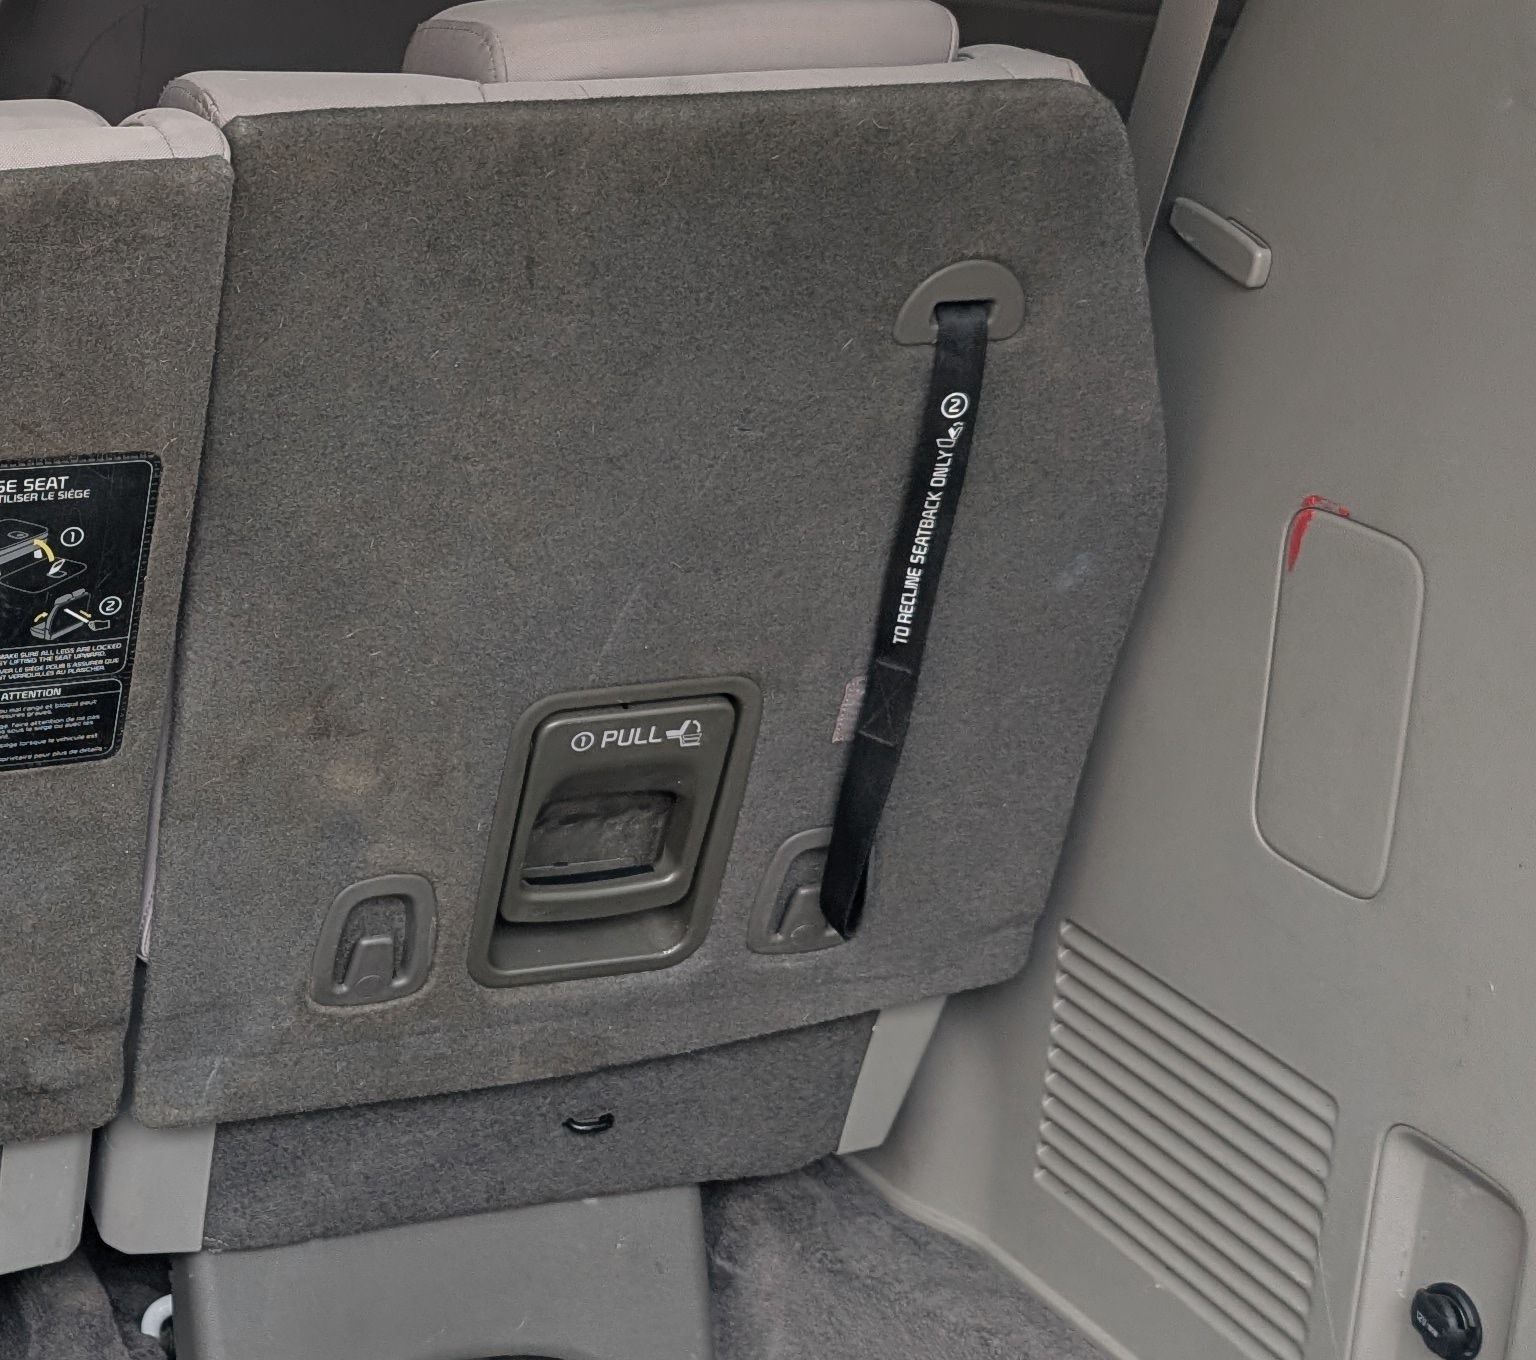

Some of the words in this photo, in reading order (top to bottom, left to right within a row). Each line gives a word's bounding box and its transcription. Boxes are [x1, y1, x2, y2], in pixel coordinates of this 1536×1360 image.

[930, 448, 953, 488] ONLY
[24, 476, 69, 492] SEAT
[41, 491, 54, 500] LE
[910, 491, 943, 565] SEATBACK
[897, 566, 922, 625] RECLINE
[893, 626, 908, 645] TO
[1, 688, 62, 701] ATTENTION
[601, 726, 662, 748] PULL
